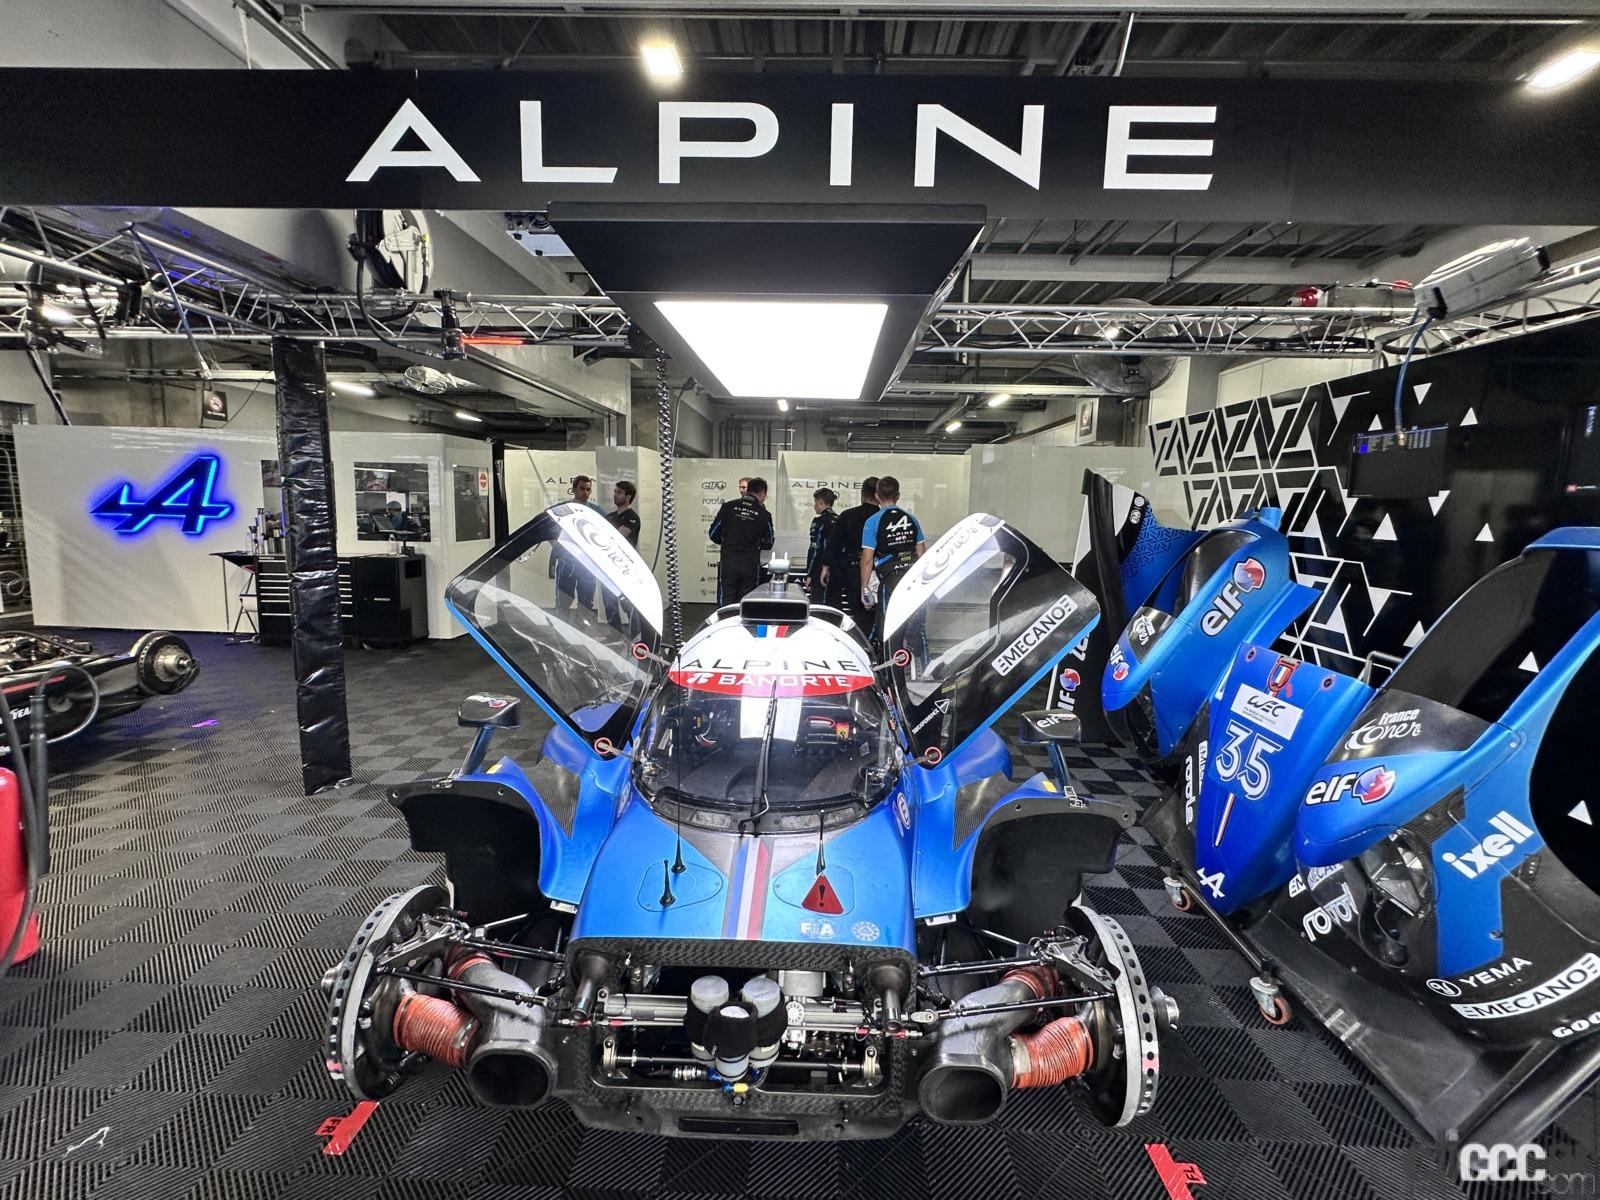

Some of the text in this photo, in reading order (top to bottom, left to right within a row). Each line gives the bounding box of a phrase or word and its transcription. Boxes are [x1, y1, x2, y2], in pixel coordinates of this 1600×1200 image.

[346, 98, 1218, 191] ALPINE
[792, 481, 862, 490] ALPINE
[887, 530, 913, 538] ALPINE
[1201, 582, 1242, 636] elf
[681, 658, 860, 673] ALPINE
[718, 675, 853, 688] BANORTE
[1247, 695, 1287, 717] WEC
[1215, 719, 1283, 801] 35
[1305, 773, 1358, 805] elf
[1442, 810, 1535, 879] ixell
[1460, 957, 1533, 987] YEMA
